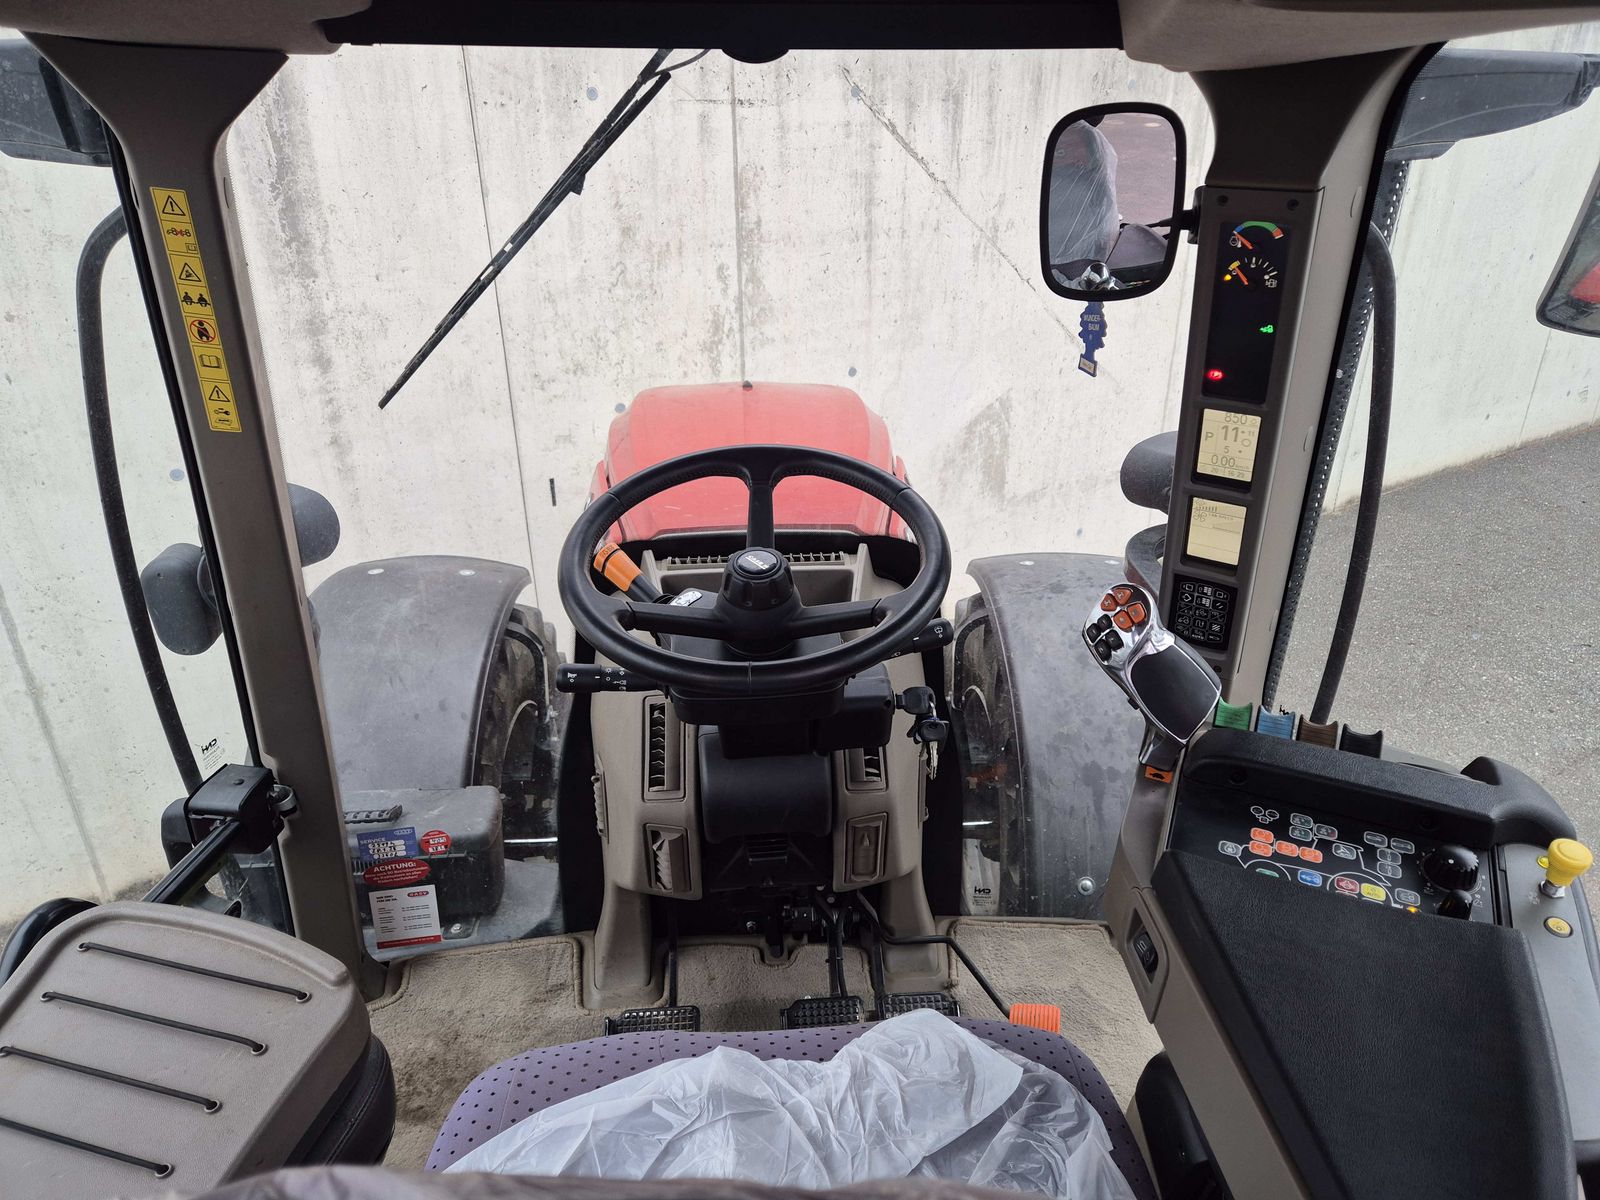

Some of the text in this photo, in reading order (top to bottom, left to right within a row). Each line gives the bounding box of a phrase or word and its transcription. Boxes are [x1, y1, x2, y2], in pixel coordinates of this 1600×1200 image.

[1225, 413, 1247, 425] 850
[1205, 432, 1214, 441] P
[1221, 425, 1240, 442] 11
[1224, 446, 1230, 454] 5
[373, 861, 417, 873] ACHTUNG:
